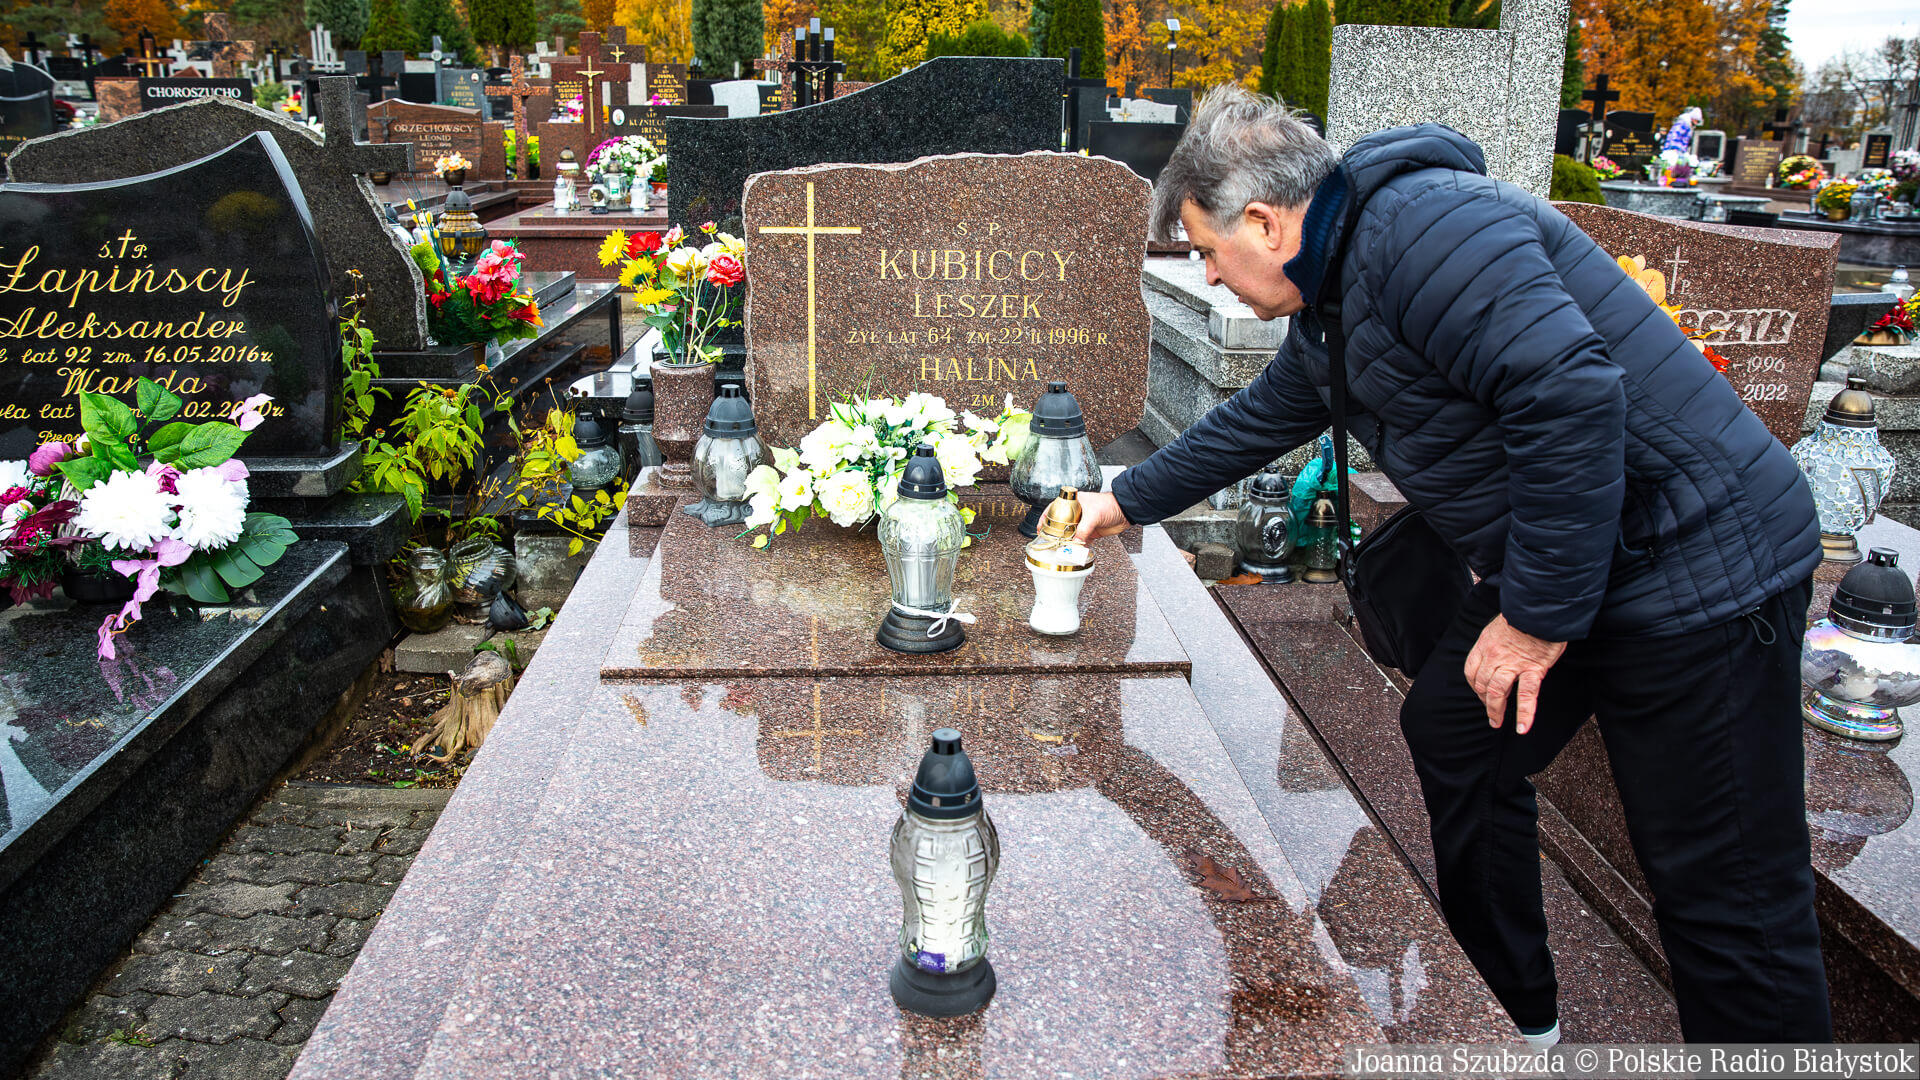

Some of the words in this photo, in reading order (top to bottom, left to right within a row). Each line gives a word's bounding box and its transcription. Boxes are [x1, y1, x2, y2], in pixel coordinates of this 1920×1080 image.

[147, 87, 242, 98] CHOROSZUCHO
[393, 124, 473, 133] ORZECHOWSCY
[879, 249, 1076, 281] KUBICCY
[914, 293, 1044, 319] LESZEK
[0, 306, 246, 340] Aleksander
[888, 331, 918, 344] LAT
[928, 326, 952, 344] 64
[1000, 327, 1022, 344] 22
[1049, 327, 1090, 345] 1996
[64, 346, 92, 364] 92
[1746, 355, 1786, 374] 1996
[919, 357, 1041, 381] HALINA
[1742, 383, 1788, 401] 2022
